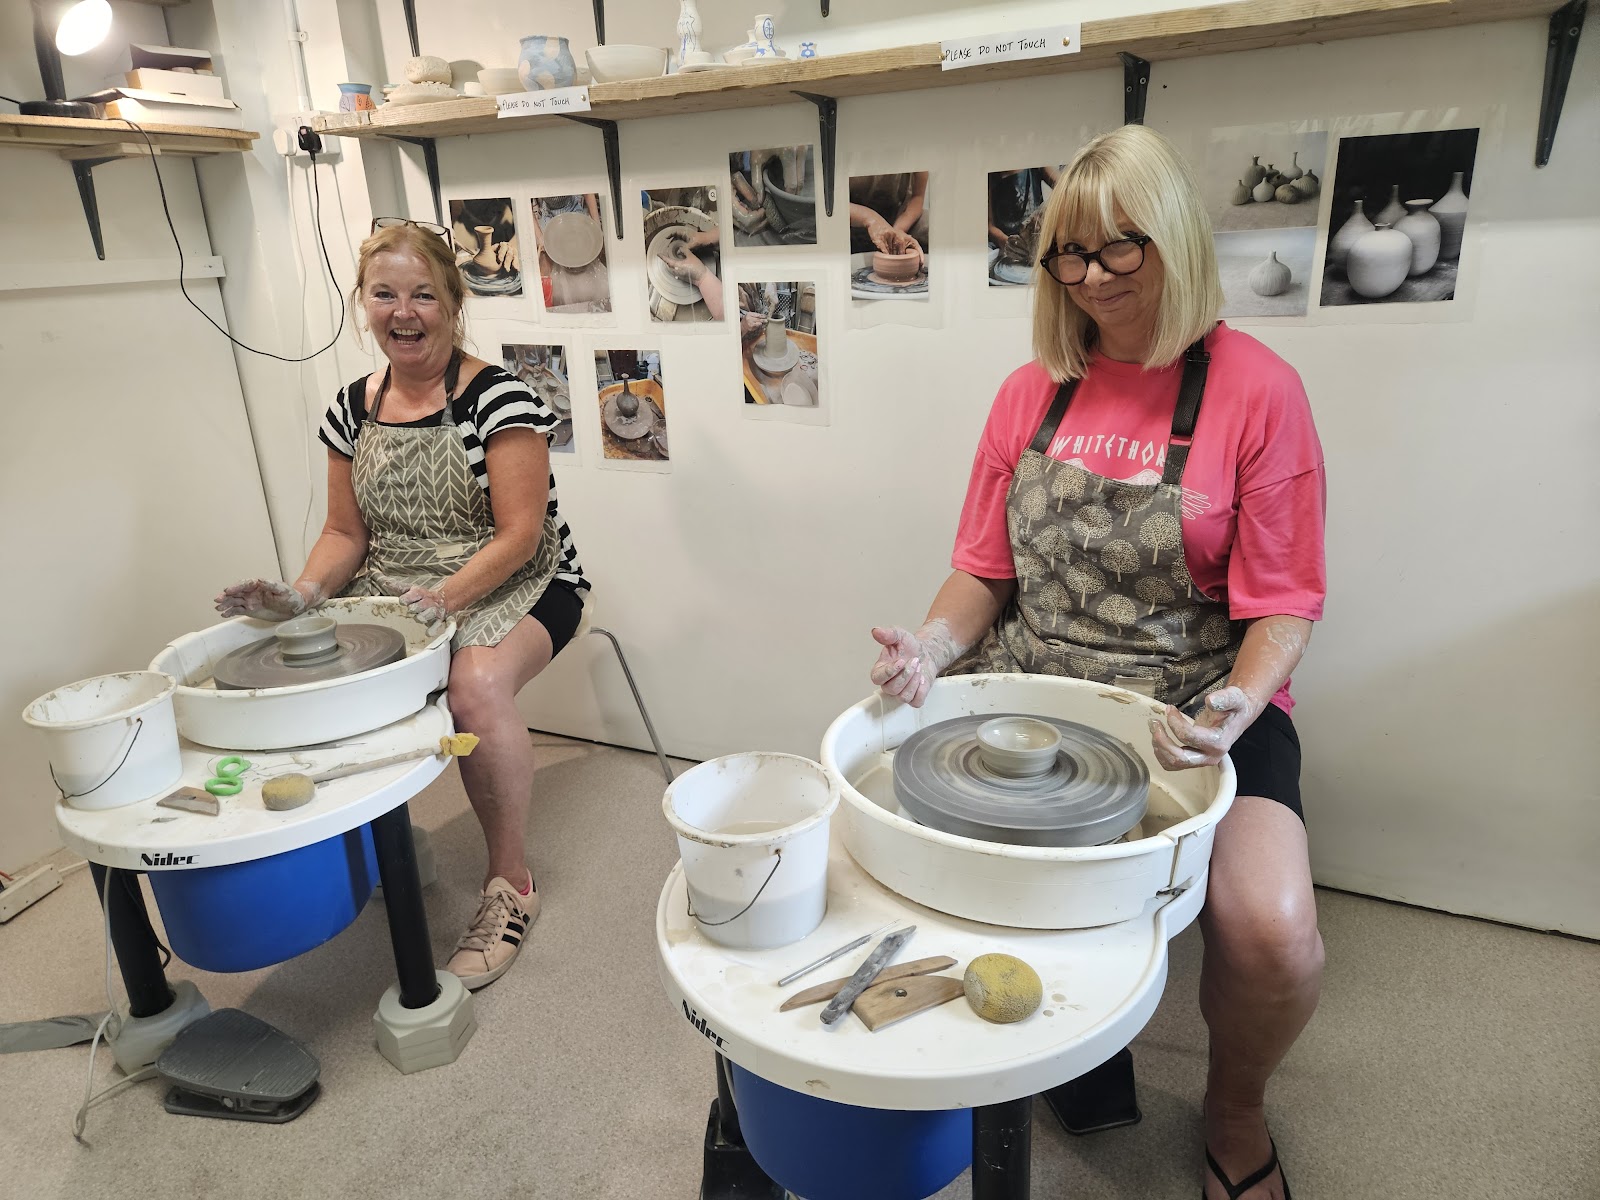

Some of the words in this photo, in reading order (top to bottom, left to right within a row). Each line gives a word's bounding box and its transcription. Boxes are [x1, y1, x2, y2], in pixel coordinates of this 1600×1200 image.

[944, 47, 972, 62] PLEASE
[978, 45, 990, 55] DO
[995, 42, 1014, 53] NOT
[1017, 38, 1046, 51] TOUCH
[502, 99, 519, 110] PLEASE
[522, 100, 530, 108] DO
[533, 98, 546, 108] NOT
[550, 97, 571, 106] TOUCH
[140, 852, 200, 866] Nidec
[681, 998, 730, 1053] Nidec
